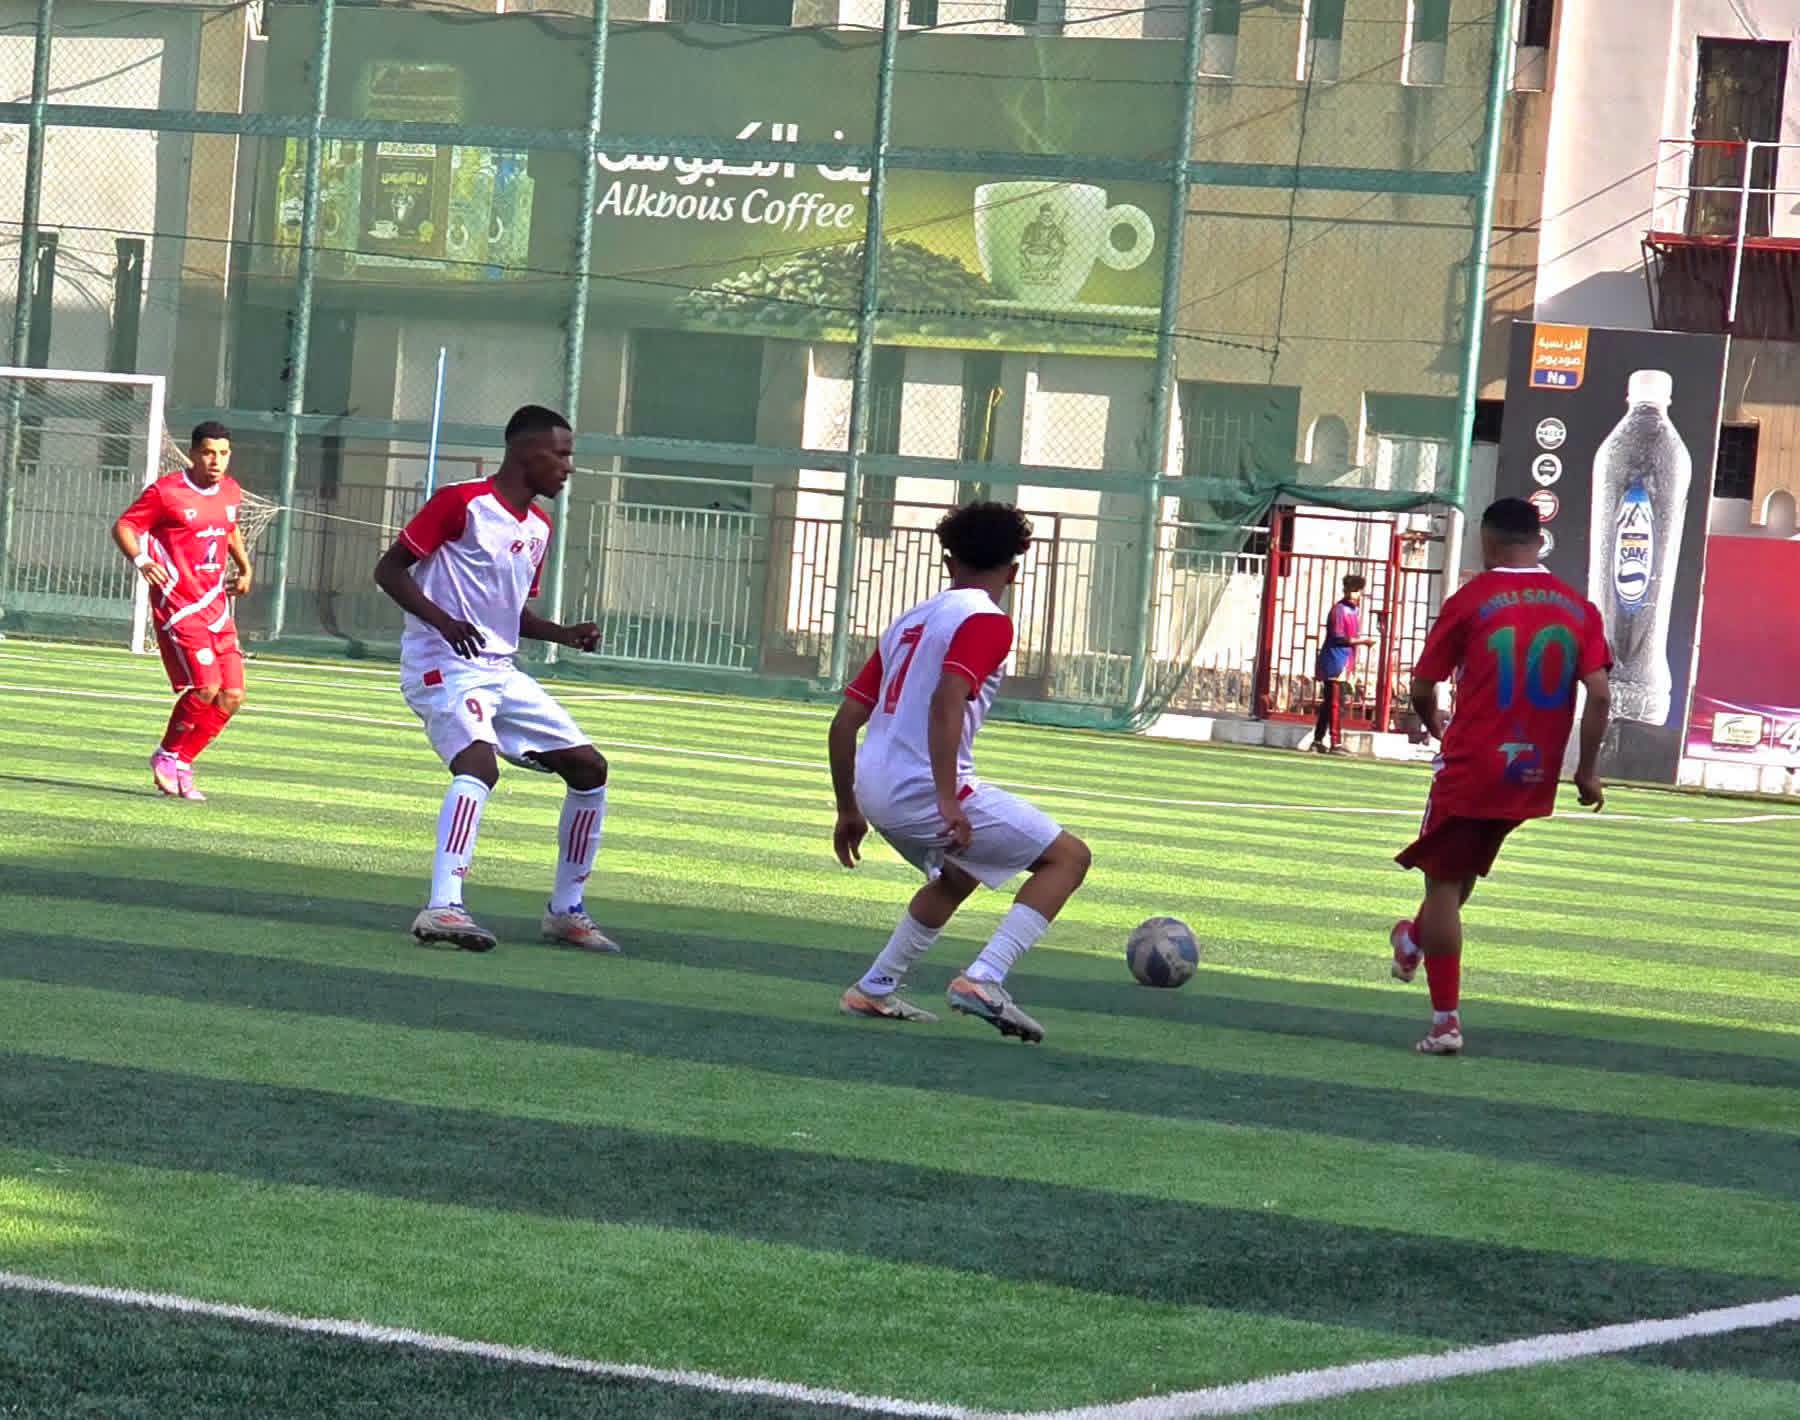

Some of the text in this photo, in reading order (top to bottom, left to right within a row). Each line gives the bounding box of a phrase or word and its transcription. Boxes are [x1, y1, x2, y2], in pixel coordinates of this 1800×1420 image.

[741, 188, 855, 232] Coffee
[1487, 624, 1577, 709] 10
[465, 698, 483, 722] 9
